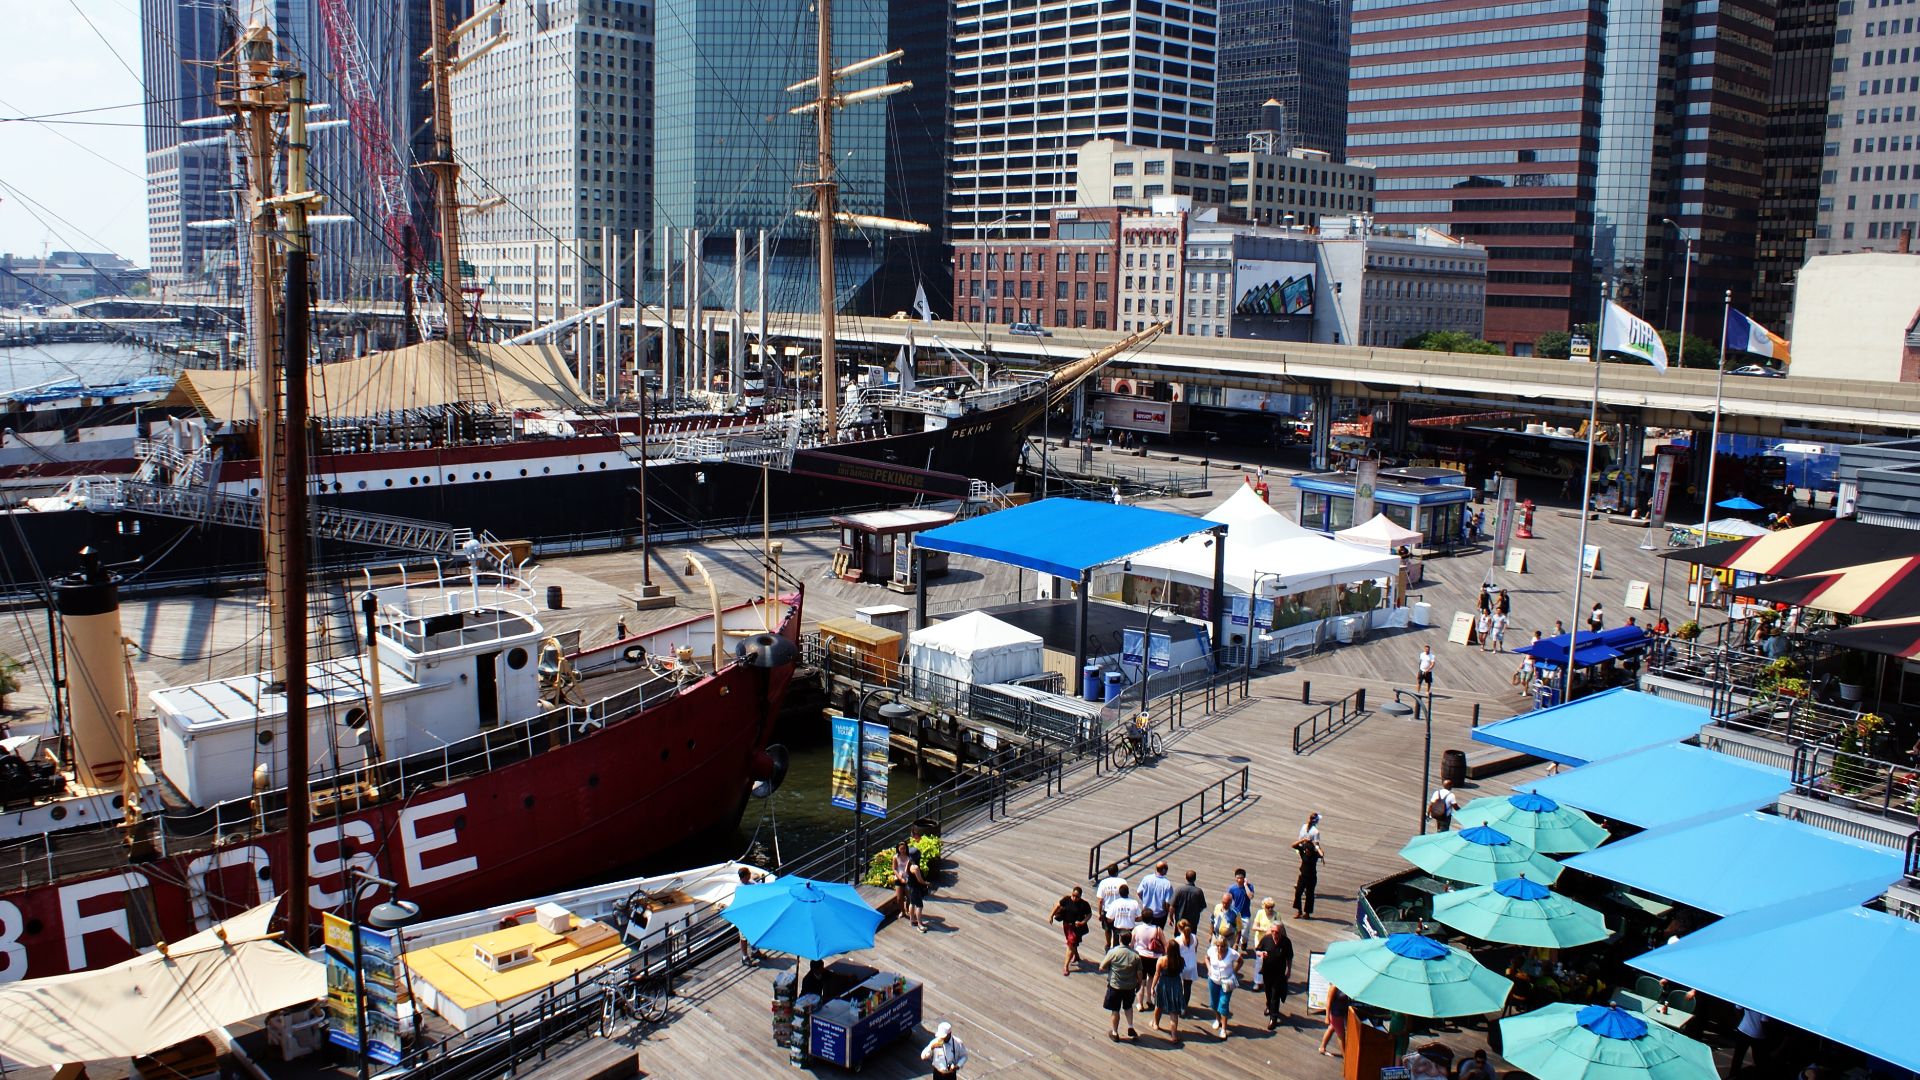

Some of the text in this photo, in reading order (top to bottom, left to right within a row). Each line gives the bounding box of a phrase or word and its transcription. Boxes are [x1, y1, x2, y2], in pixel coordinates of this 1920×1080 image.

[952, 422, 992, 439] PEKING
[874, 469, 914, 486] PEKING
[869, 1009, 891, 1027] seaport
[892, 999, 908, 1012] water
